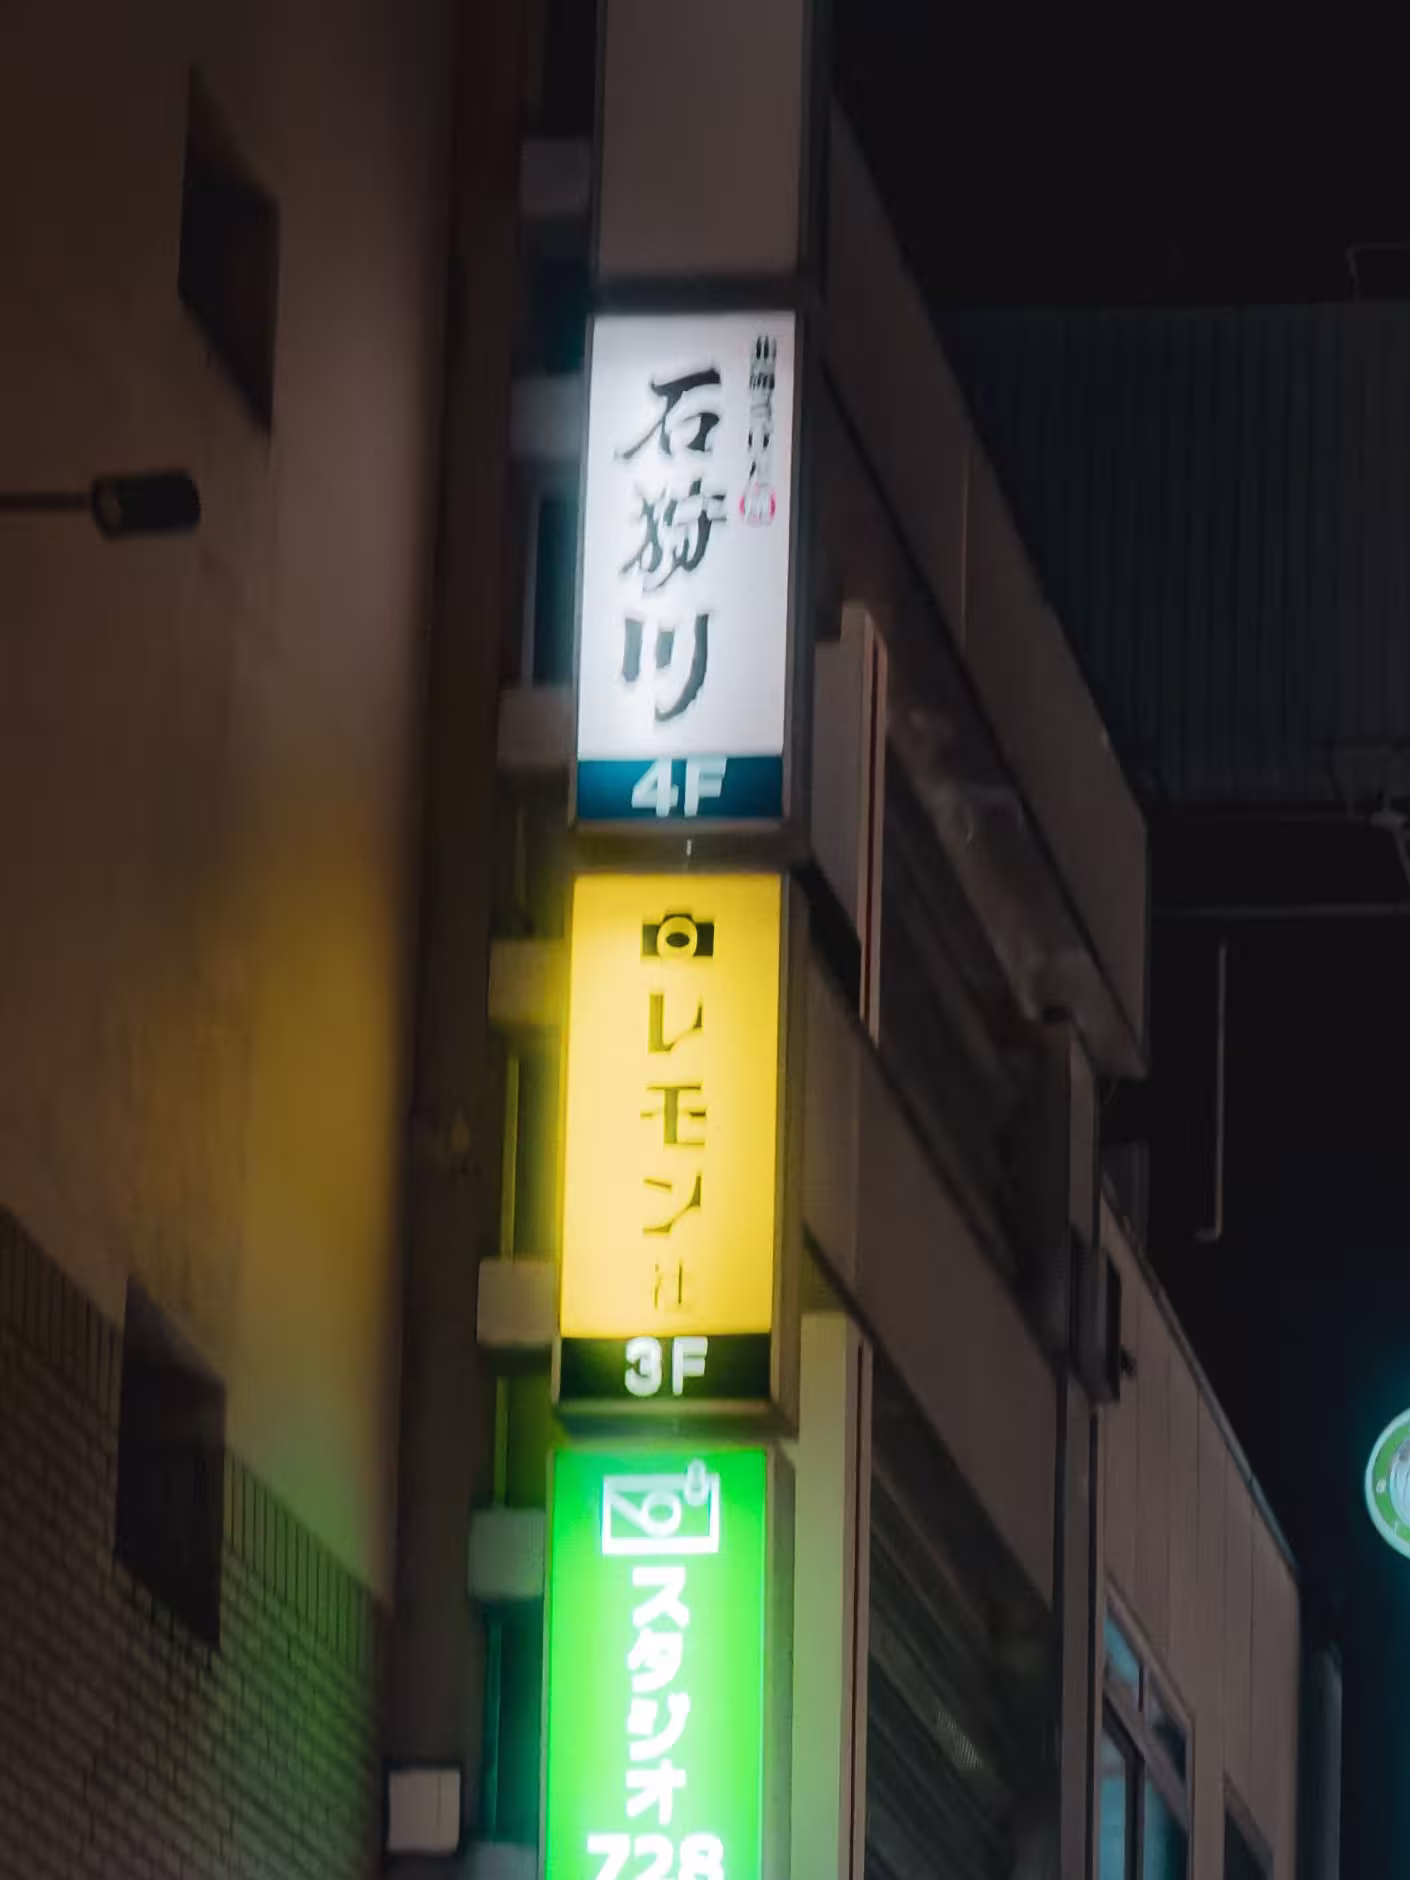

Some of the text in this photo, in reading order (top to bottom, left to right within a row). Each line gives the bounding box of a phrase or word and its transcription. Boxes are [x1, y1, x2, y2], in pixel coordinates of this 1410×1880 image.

[614, 366, 727, 723] 石狩川
[631, 755, 727, 819] 4F
[624, 1335, 709, 1397] 3F
[625, 1565, 690, 1825] スタジオ
